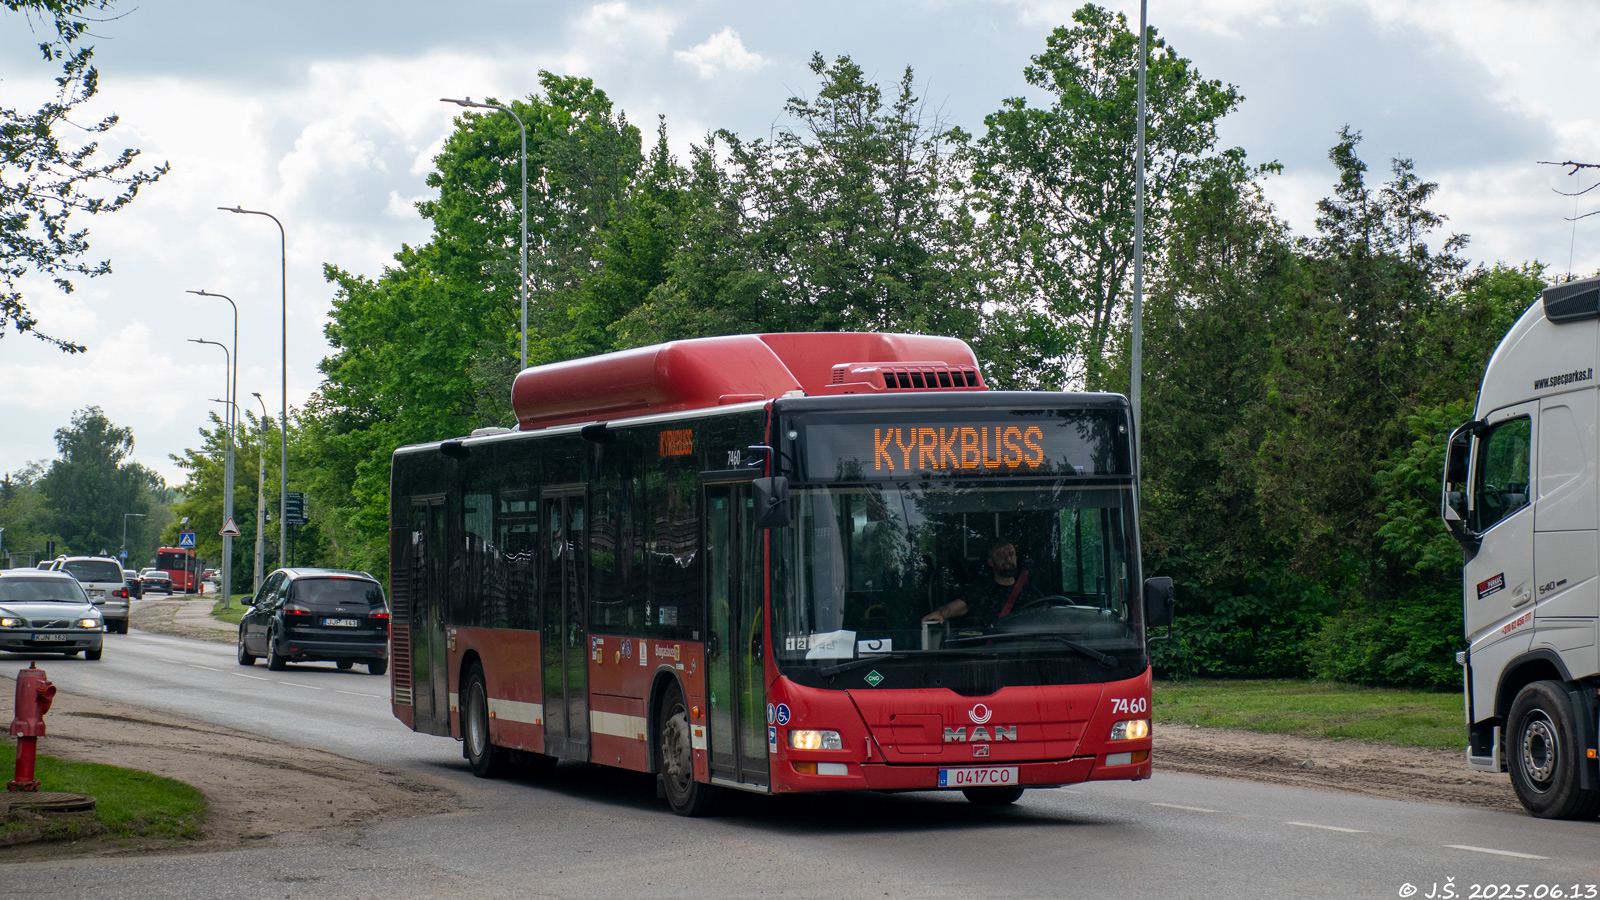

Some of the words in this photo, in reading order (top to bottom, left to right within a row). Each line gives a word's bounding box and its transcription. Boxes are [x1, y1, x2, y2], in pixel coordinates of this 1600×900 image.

[1534, 367, 1593, 390] www.specparkas.lt
[874, 426, 1044, 470] KYRKBUSS
[727, 449, 741, 466] 7460
[1539, 581, 1555, 594] 540
[1110, 697, 1147, 714] 7460
[944, 726, 1017, 743] MAN
[956, 769, 1010, 784] 0417CO
